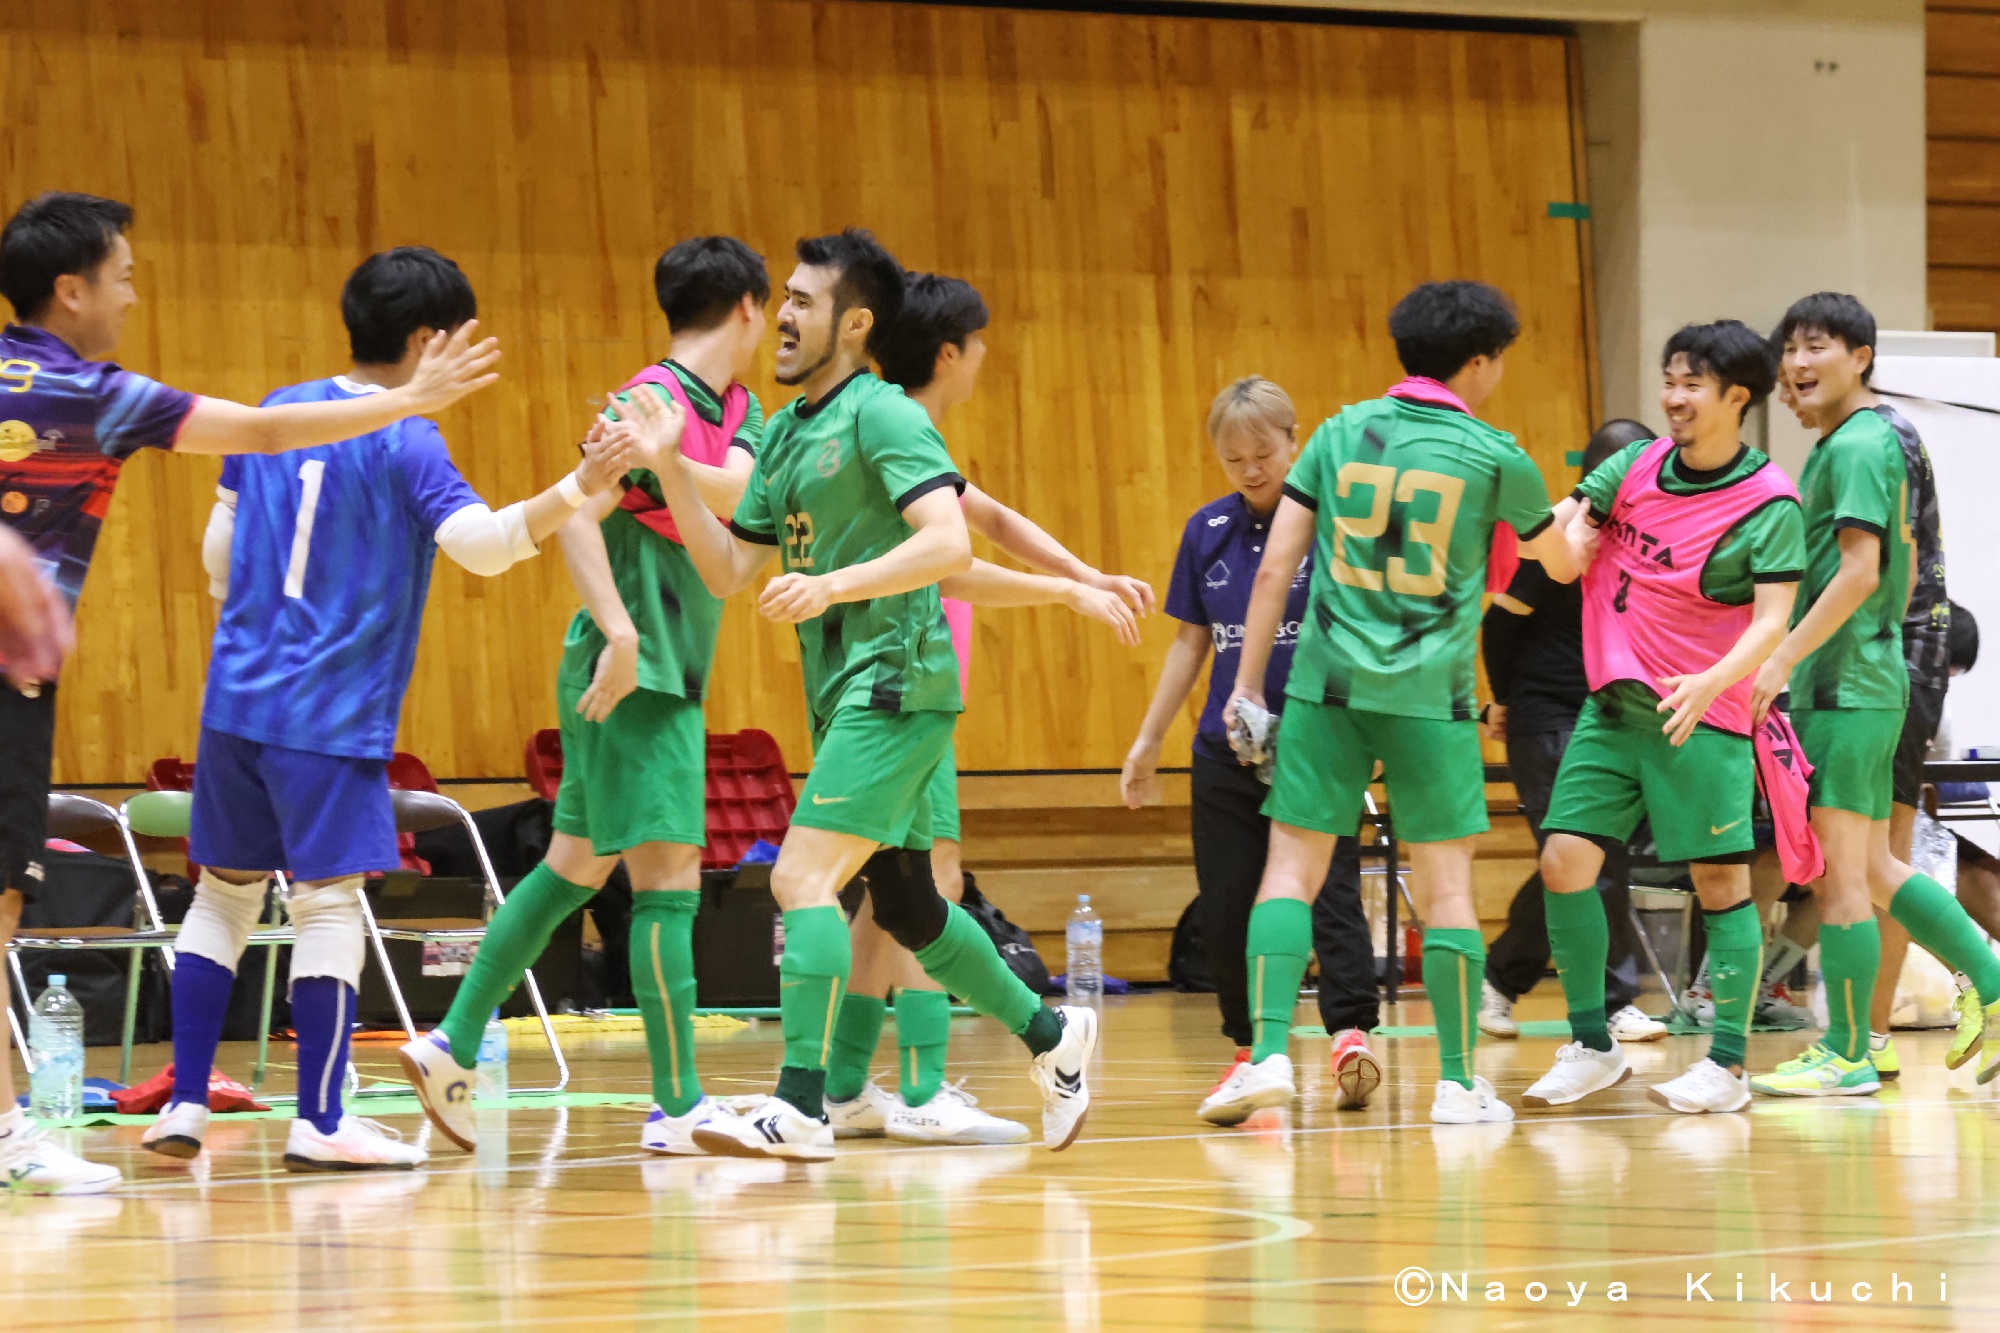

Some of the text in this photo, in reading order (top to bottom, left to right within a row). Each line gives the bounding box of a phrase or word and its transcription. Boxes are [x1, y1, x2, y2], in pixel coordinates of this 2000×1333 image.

[283, 458, 326, 599] 1
[784, 511, 815, 568] 22
[1330, 461, 1466, 597] 23
